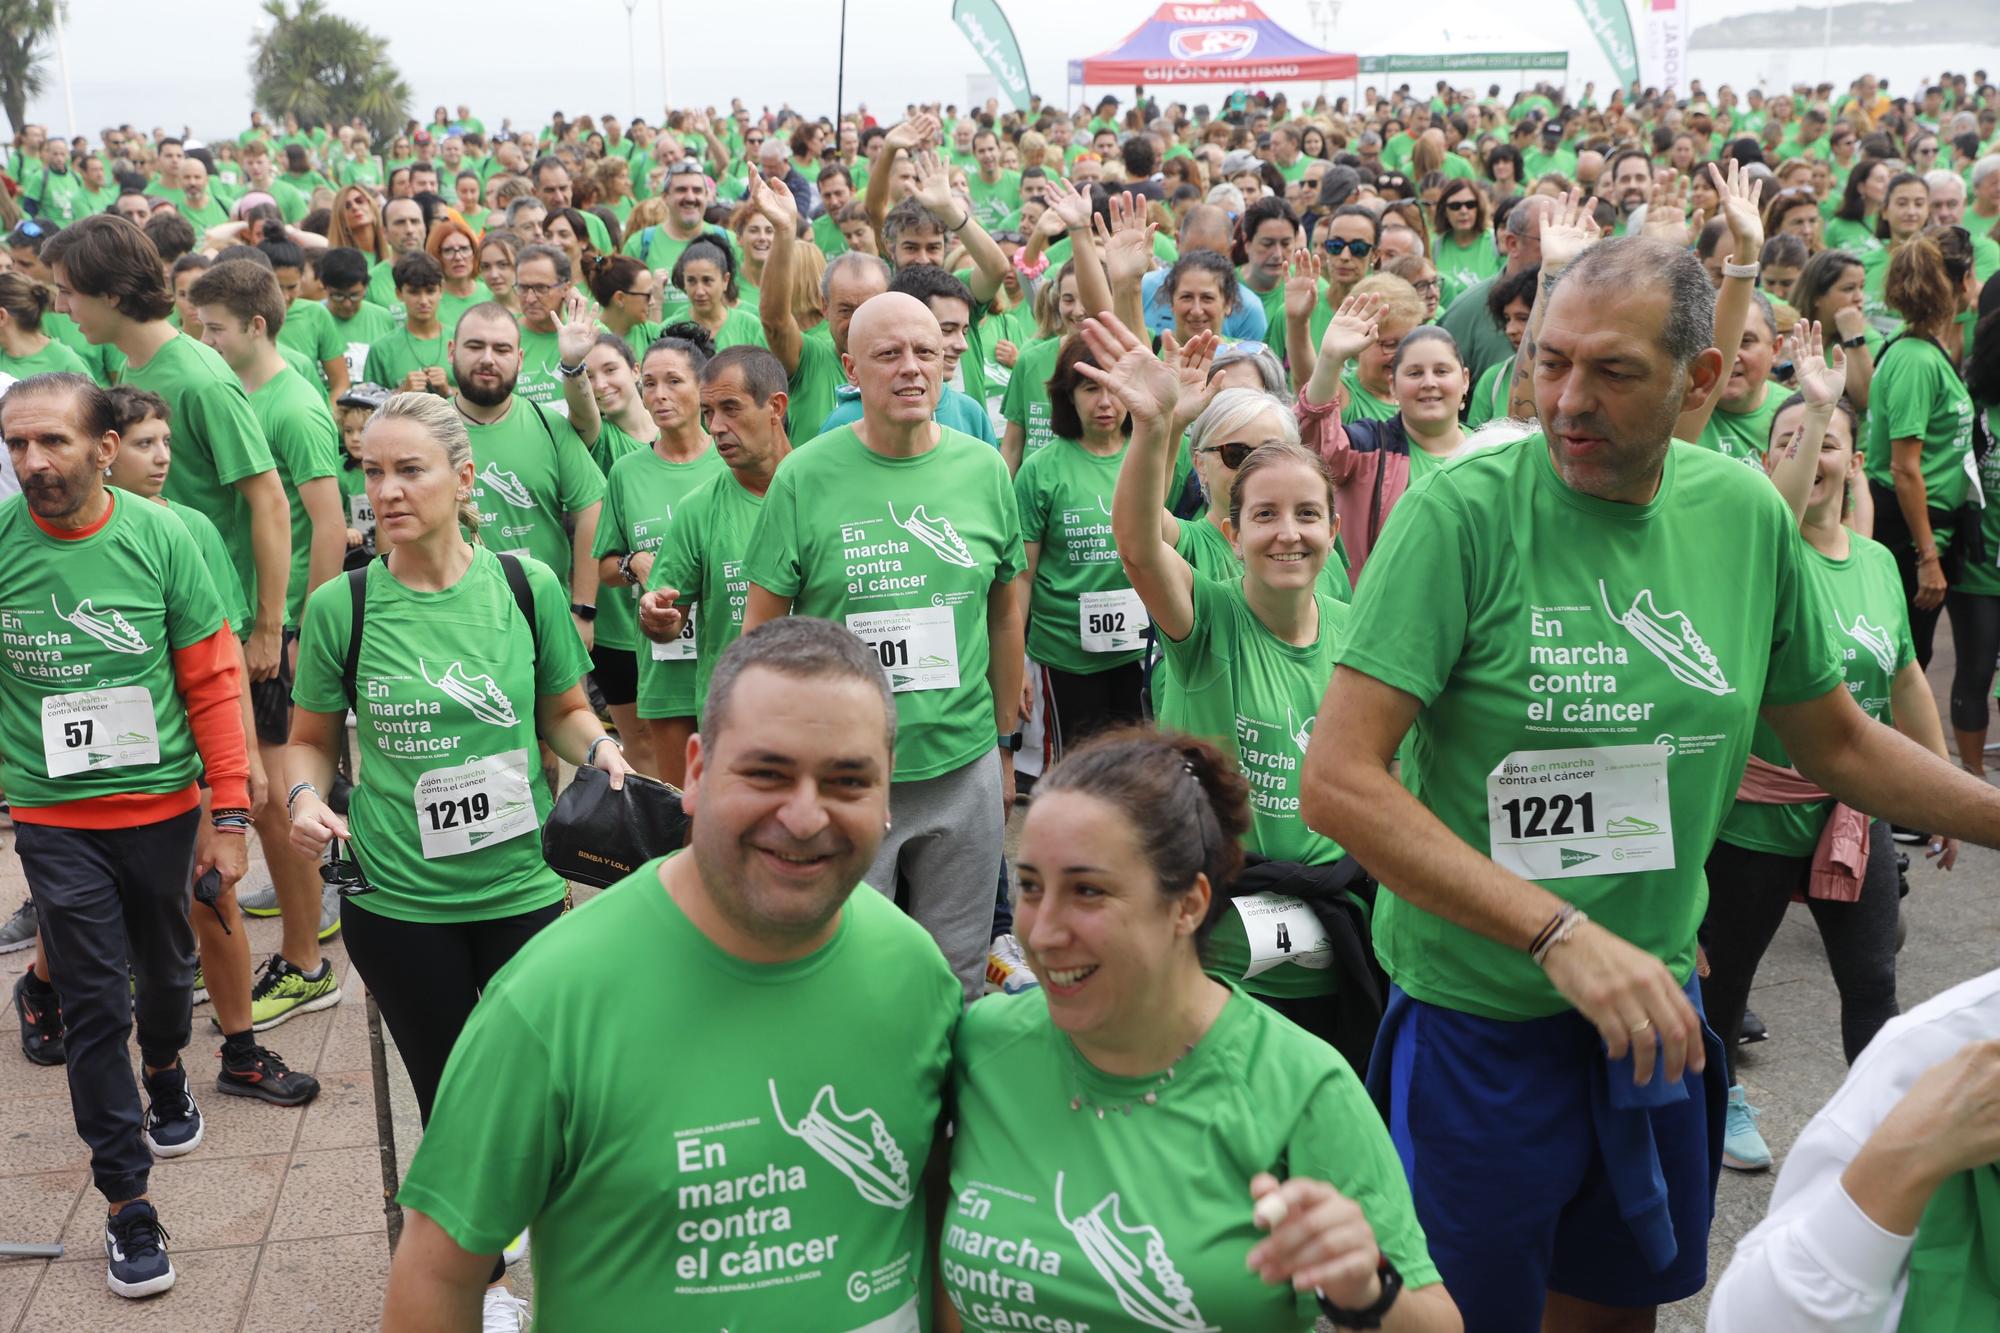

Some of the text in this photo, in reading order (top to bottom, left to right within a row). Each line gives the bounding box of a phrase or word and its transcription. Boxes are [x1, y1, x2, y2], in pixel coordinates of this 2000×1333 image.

[1143, 62, 1299, 81] GIJÓN ATLETISMO
[518, 382, 555, 393] marcha
[1030, 404, 1043, 415] En
[1063, 512, 1080, 524] En
[634, 525, 647, 537] En
[842, 527, 865, 543] En
[1065, 523, 1112, 537] marcha
[844, 540, 909, 559] marcha
[1067, 537, 1106, 549] contra
[1069, 549, 1121, 561] el cánce
[846, 559, 902, 576] contra
[848, 574, 927, 593] el cáncer
[2, 613, 22, 629] En
[732, 608, 742, 620] el
[1089, 612, 1125, 634] 502
[1531, 612, 1563, 638] En
[3, 631, 72, 646] marcha
[7, 649, 62, 661] contra
[1529, 641, 1629, 665] marcha
[13, 661, 92, 677] el cáncer
[367, 681, 389, 698] En
[1528, 670, 1617, 694] contra
[369, 699, 441, 716] marcha
[1527, 697, 1655, 722] el cáncer
[64, 719, 93, 748] 57
[373, 719, 431, 734] contra
[378, 735, 461, 752] el cáncer
[1531, 765, 1545, 773] en
[1549, 758, 1594, 771] marcha
[420, 778, 441, 788] Gijón
[454, 768, 485, 781] marcha
[421, 776, 487, 794] contra el cáncer
[1499, 770, 1595, 785] contra el cáncer
[425, 792, 489, 831] 1219
[1502, 791, 1595, 839] 1221
[578, 850, 603, 864] BIMBA
[610, 860, 631, 872] LOLA
[1247, 908, 1271, 917] contra
[1279, 902, 1304, 913] cáncer
[1276, 922, 1292, 954] 4
[677, 1138, 726, 1173] En
[678, 1163, 807, 1210] marcha
[677, 1206, 792, 1243] contra
[676, 1247, 708, 1279] el
[719, 1234, 839, 1277] cáncer
[946, 1224, 1062, 1277] marcha
[943, 1257, 1036, 1304] contra
